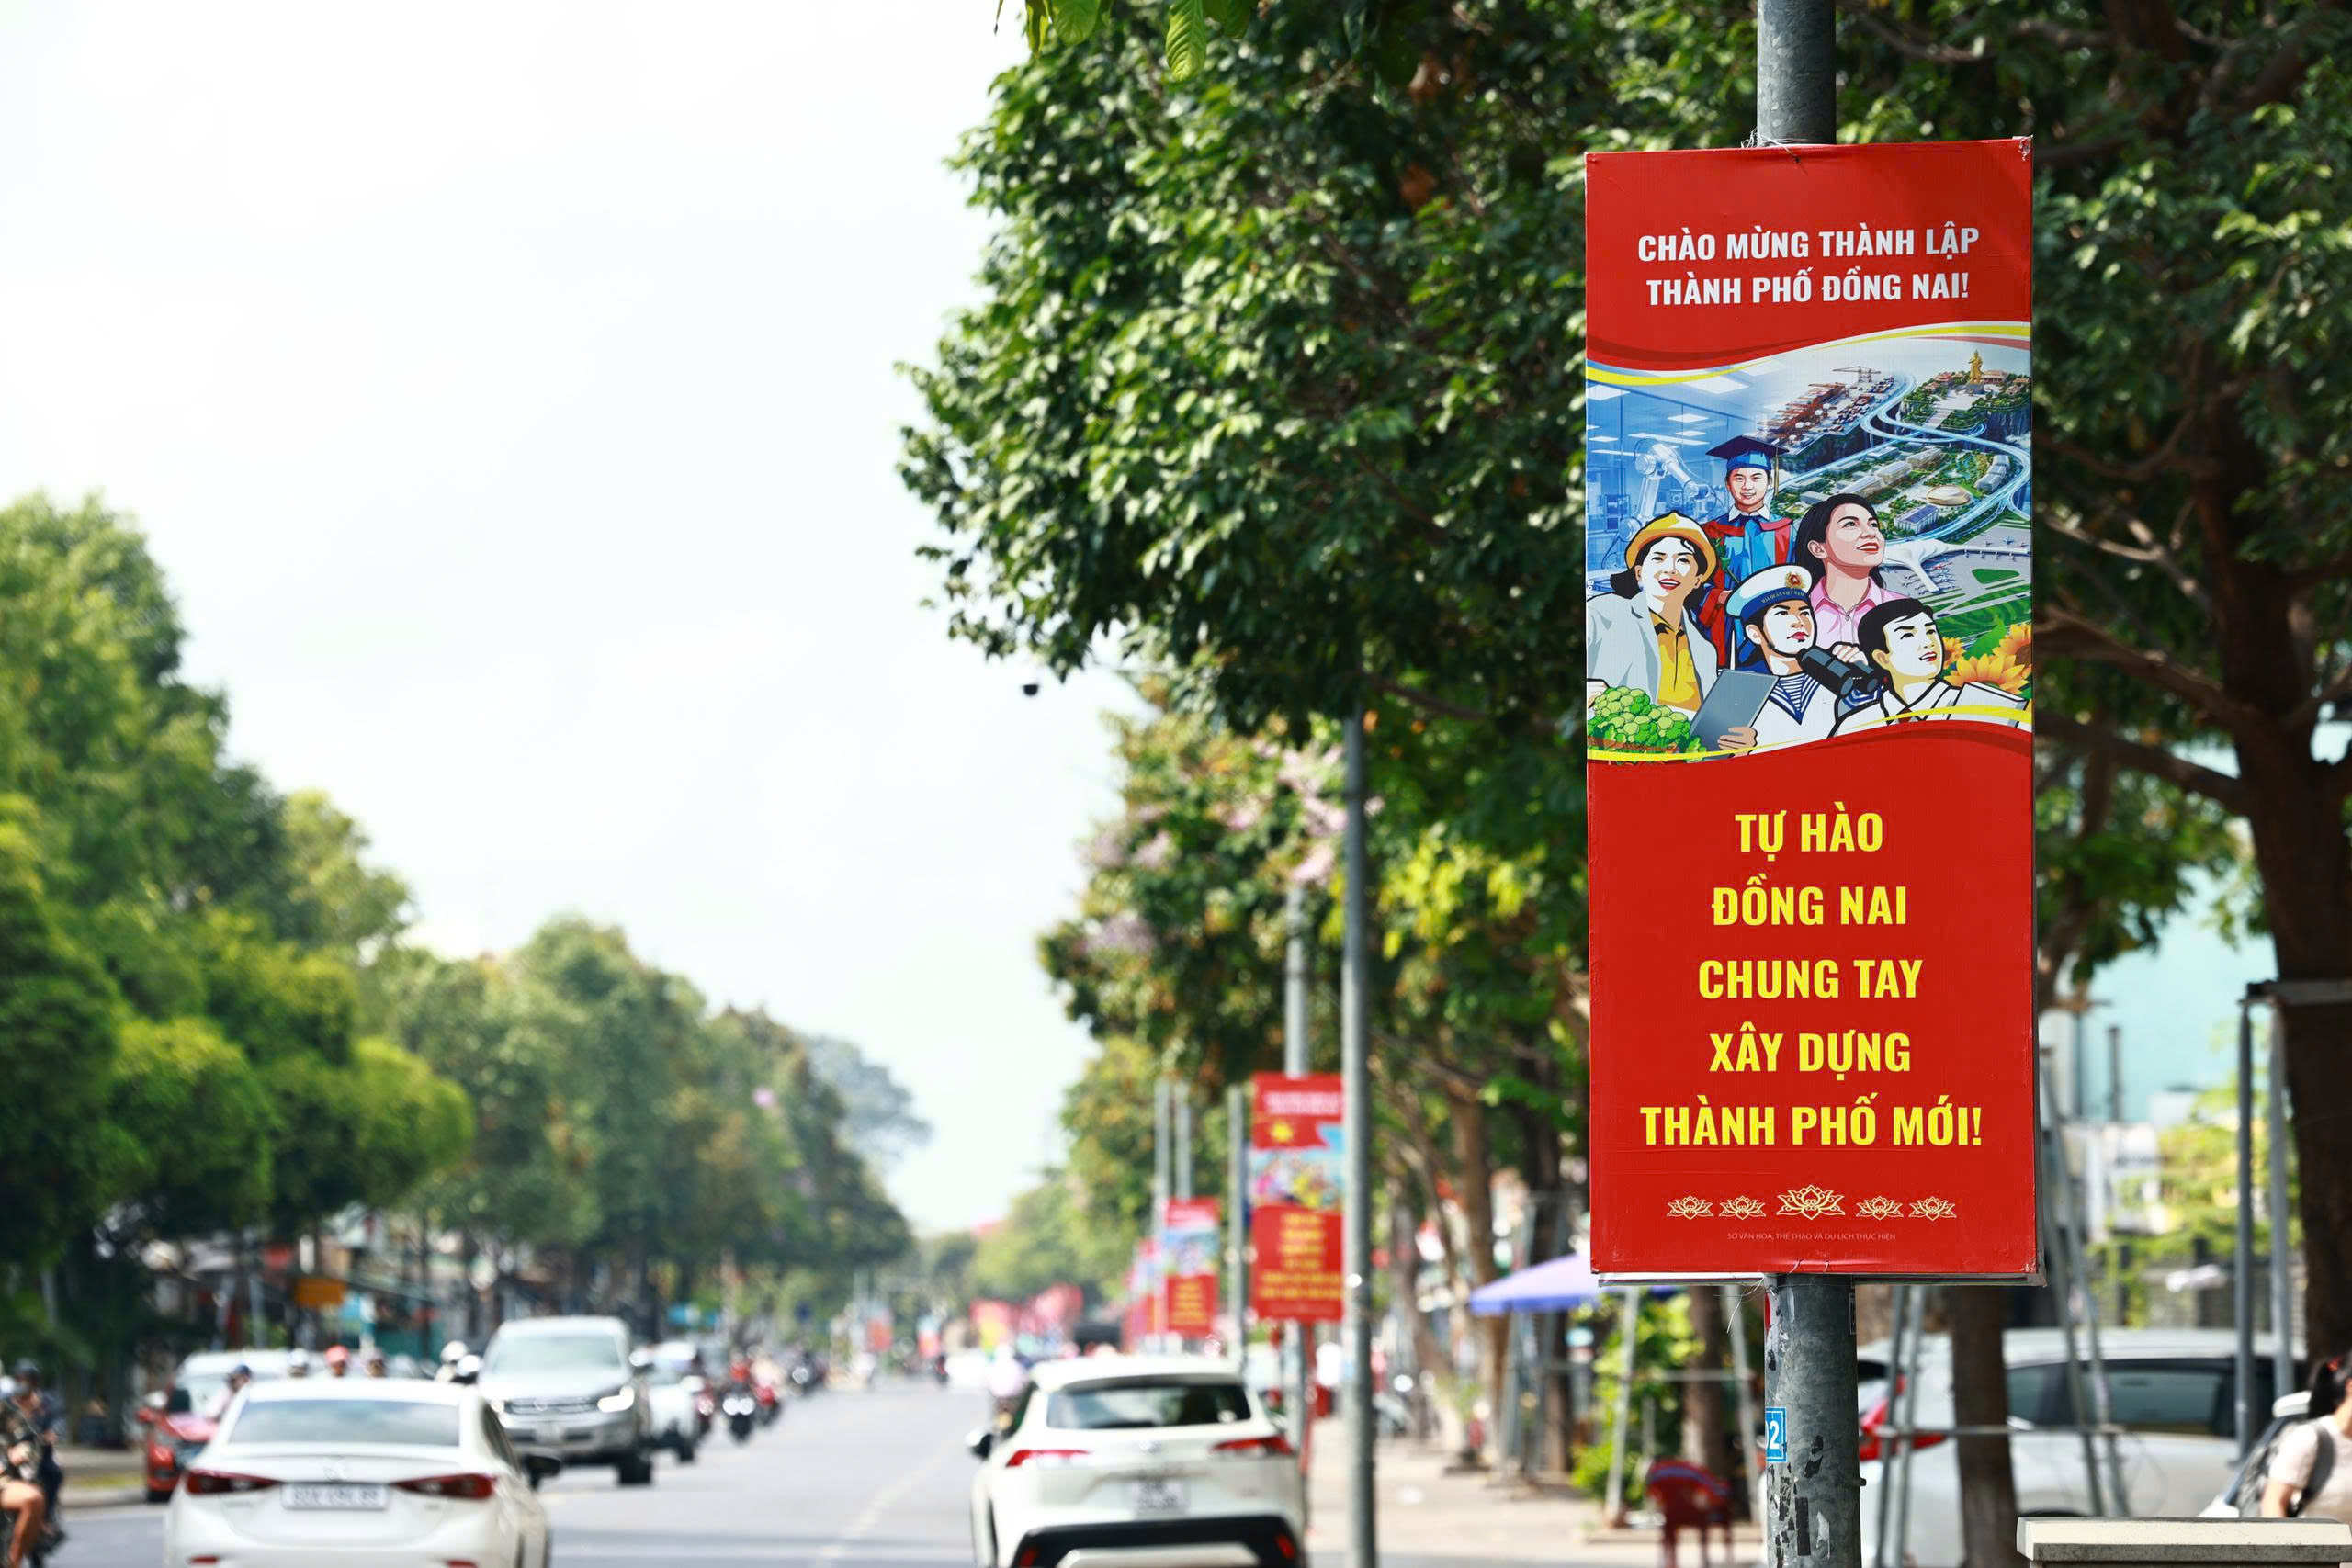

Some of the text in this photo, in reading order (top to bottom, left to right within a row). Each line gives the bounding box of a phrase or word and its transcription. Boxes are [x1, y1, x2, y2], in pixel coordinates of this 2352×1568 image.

[1639, 220, 1979, 262] CHÀO MỪNG THÀNH LẬP
[1646, 265, 1969, 306] THÀNH PHỐ ĐỒNG NAI!
[1735, 801, 1883, 862] TỰ HÀO
[1712, 873, 1906, 926] ĐỒNG NAI
[1700, 959, 1923, 999] CHUNG TAY
[1710, 1021, 1911, 1081] XÂY DỰNG
[1640, 1091, 1982, 1146] THÀNH PHỐ MỚI!
